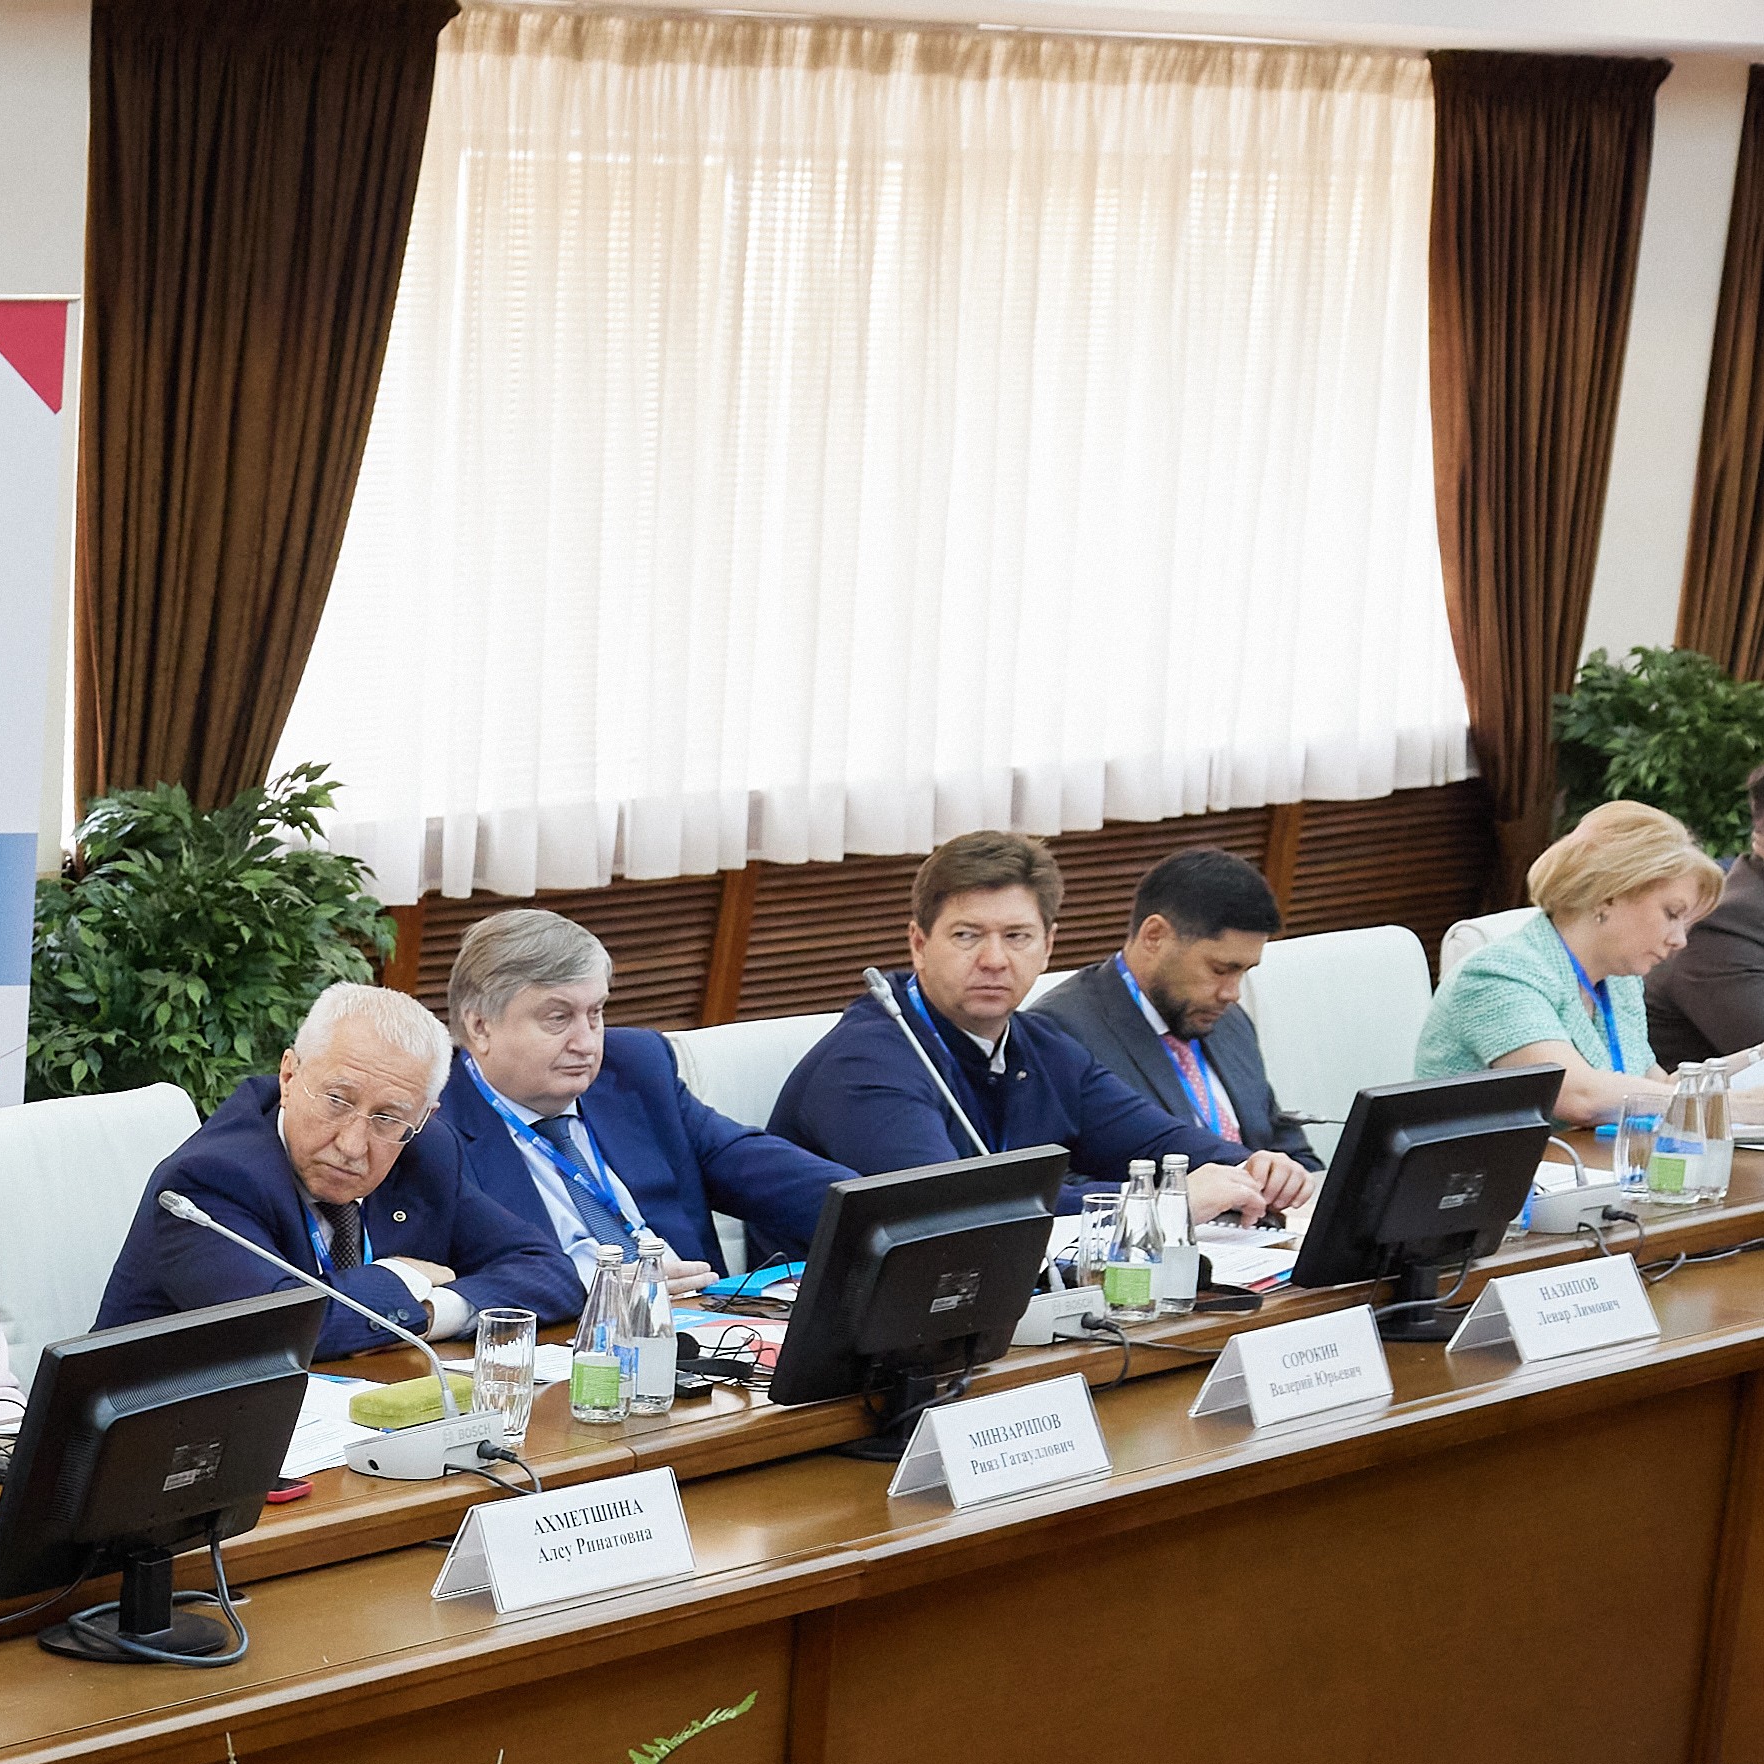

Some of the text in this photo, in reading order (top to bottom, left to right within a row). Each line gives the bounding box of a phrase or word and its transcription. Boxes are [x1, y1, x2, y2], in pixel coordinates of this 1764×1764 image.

[1539, 1277, 1599, 1301] НАЗИПОВ
[1281, 1342, 1339, 1369] СОРОКИН
[458, 1422, 491, 1441] BOSCH
[967, 1412, 1062, 1447] МИНЗАРИПОВ
[533, 1499, 643, 1535] АХМЕТШИНА
[538, 1527, 653, 1564] Алсу Ринатовна
